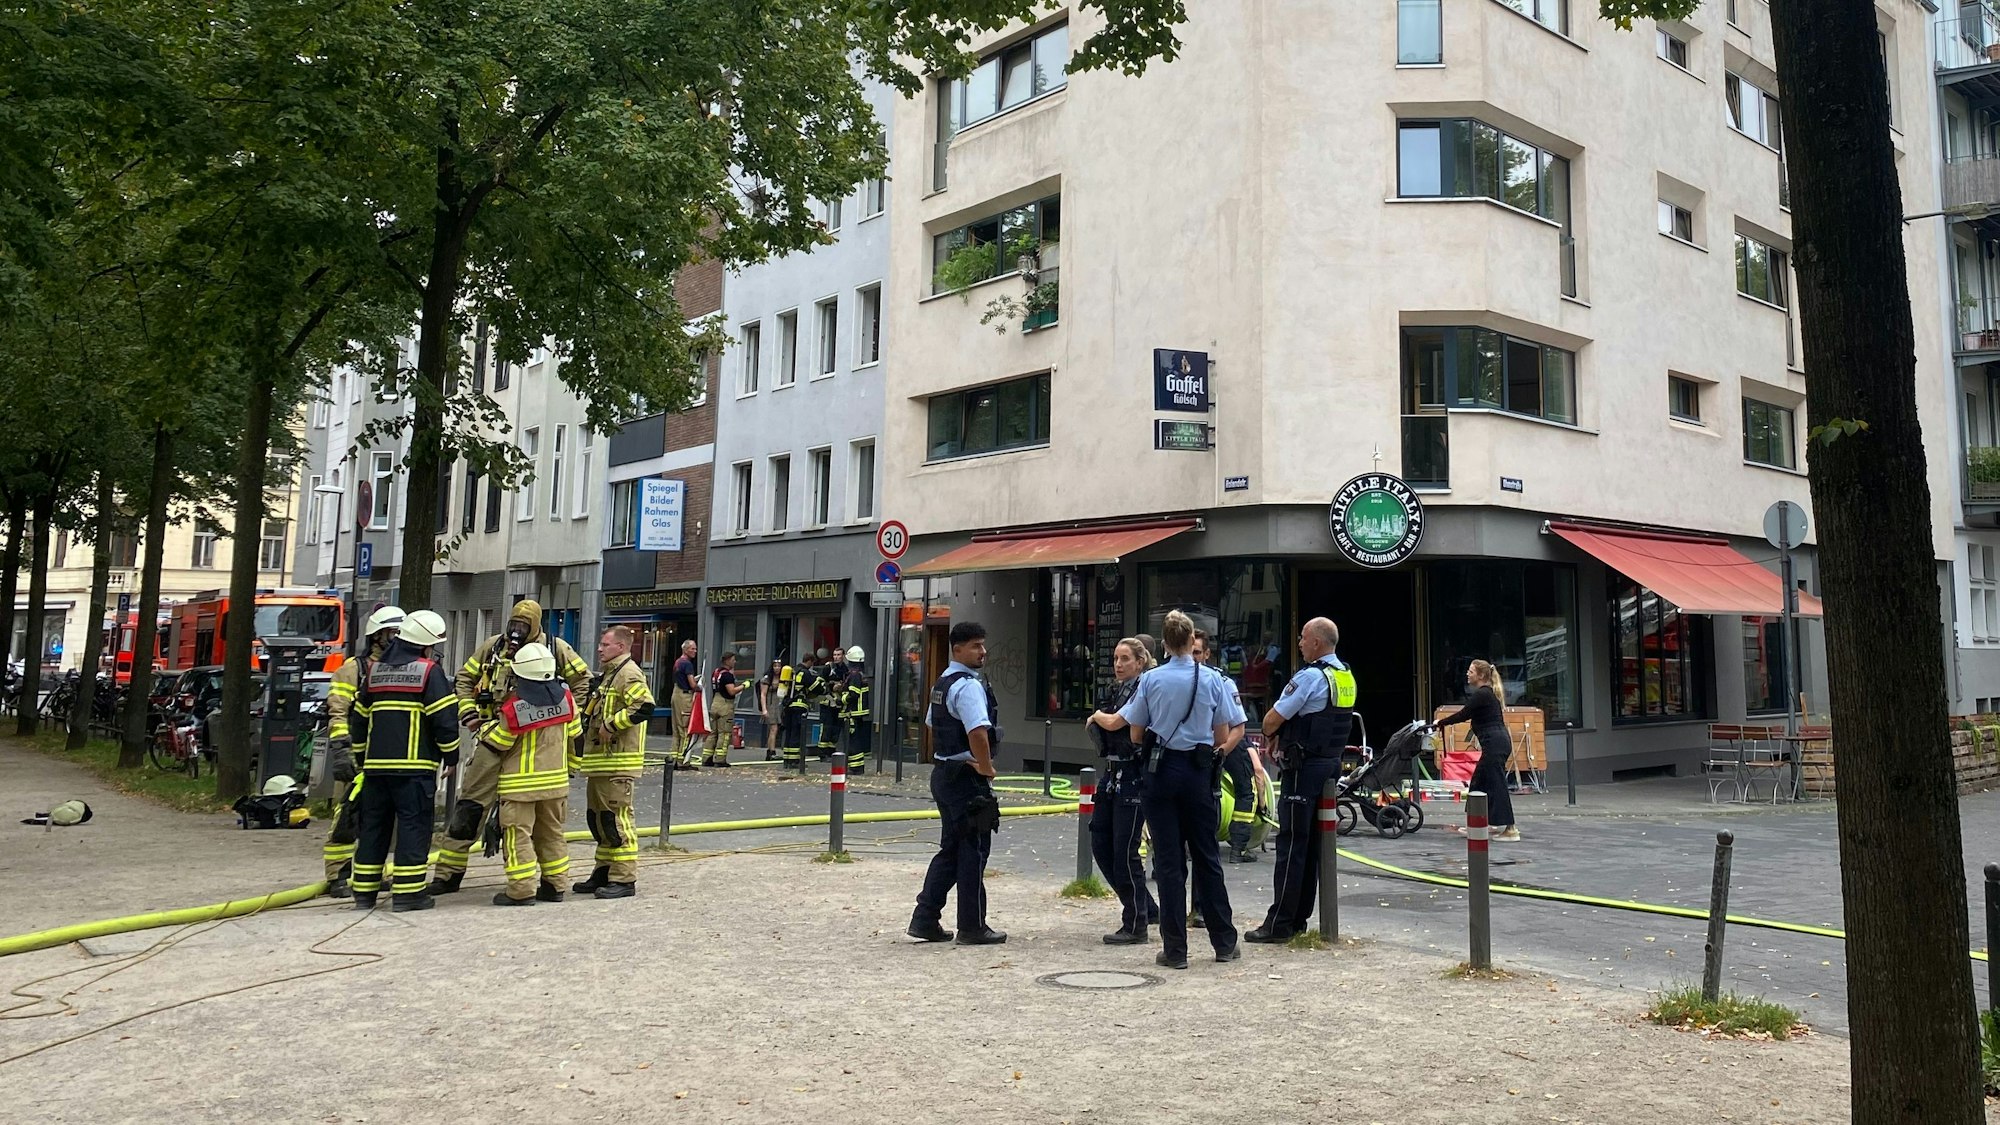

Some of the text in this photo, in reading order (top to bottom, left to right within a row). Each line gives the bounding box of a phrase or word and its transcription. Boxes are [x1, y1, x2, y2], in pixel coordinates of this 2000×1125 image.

[1166, 374, 1205, 395] Gaffel
[1173, 393, 1198, 406] Kölsch
[647, 483, 678, 494] Spiegel
[650, 495, 674, 505] Bilder
[1332, 477, 1421, 523] LITTLE ITALY
[644, 506, 679, 516] Rahmen
[651, 518, 671, 528] Glas
[883, 531, 902, 549] 30
[1337, 532, 1417, 564] CAFE RESTAURANT BAR
[635, 591, 690, 607] SPIEGELHAUS
